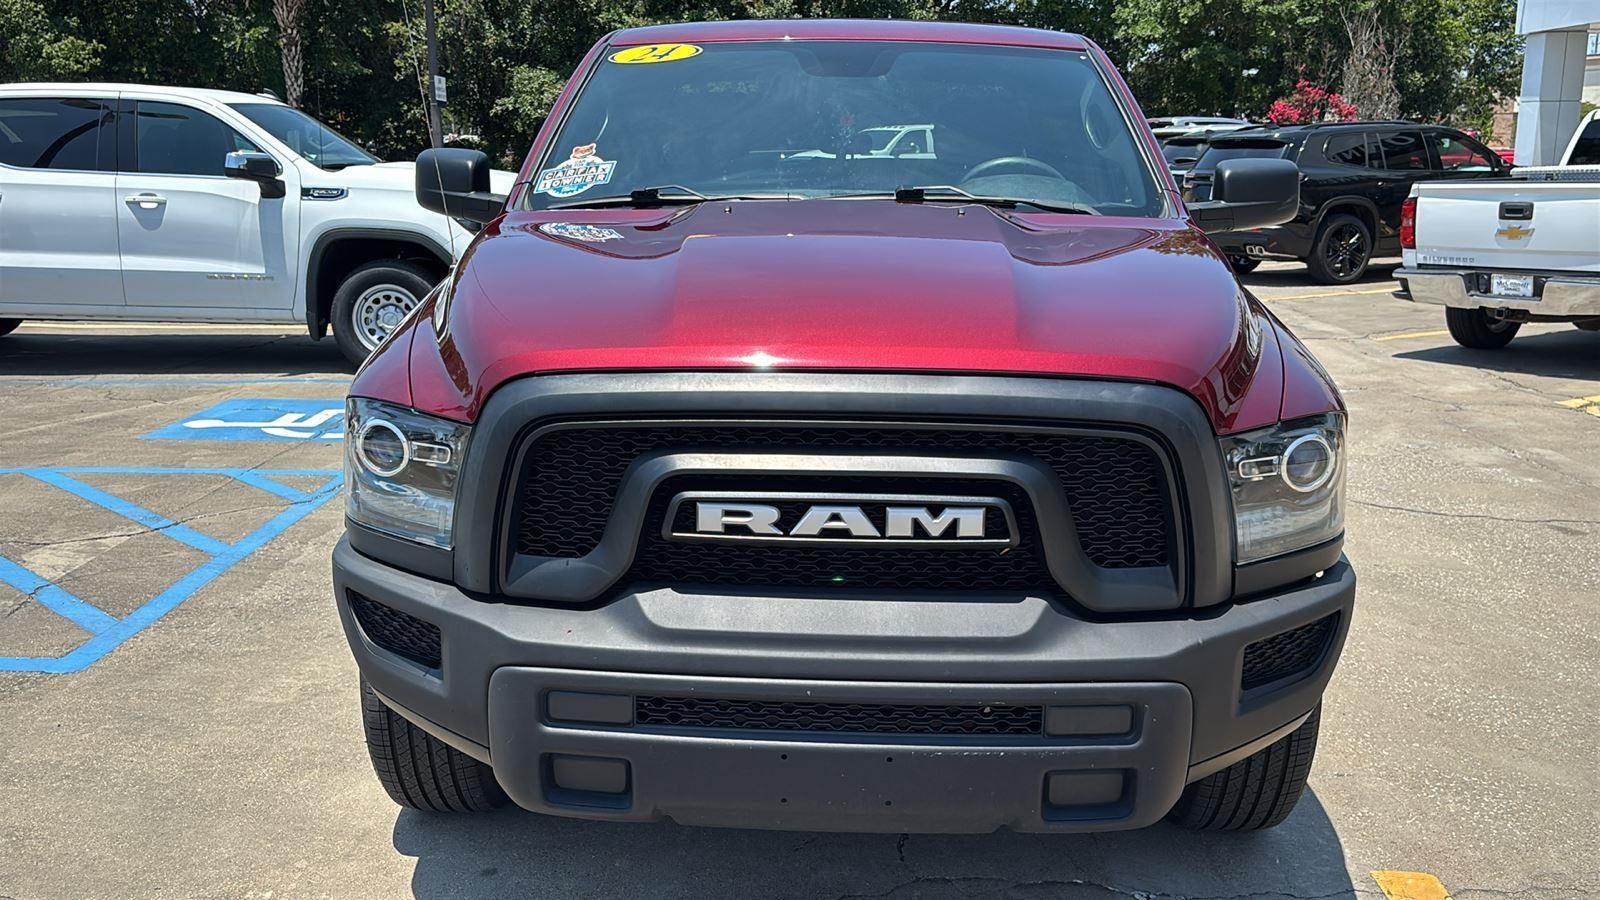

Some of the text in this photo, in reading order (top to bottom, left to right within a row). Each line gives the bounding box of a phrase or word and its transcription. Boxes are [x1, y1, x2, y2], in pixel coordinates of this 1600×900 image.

[628, 45, 682, 62] 24
[544, 166, 609, 180] CARFAX
[696, 501, 986, 538] RAM
